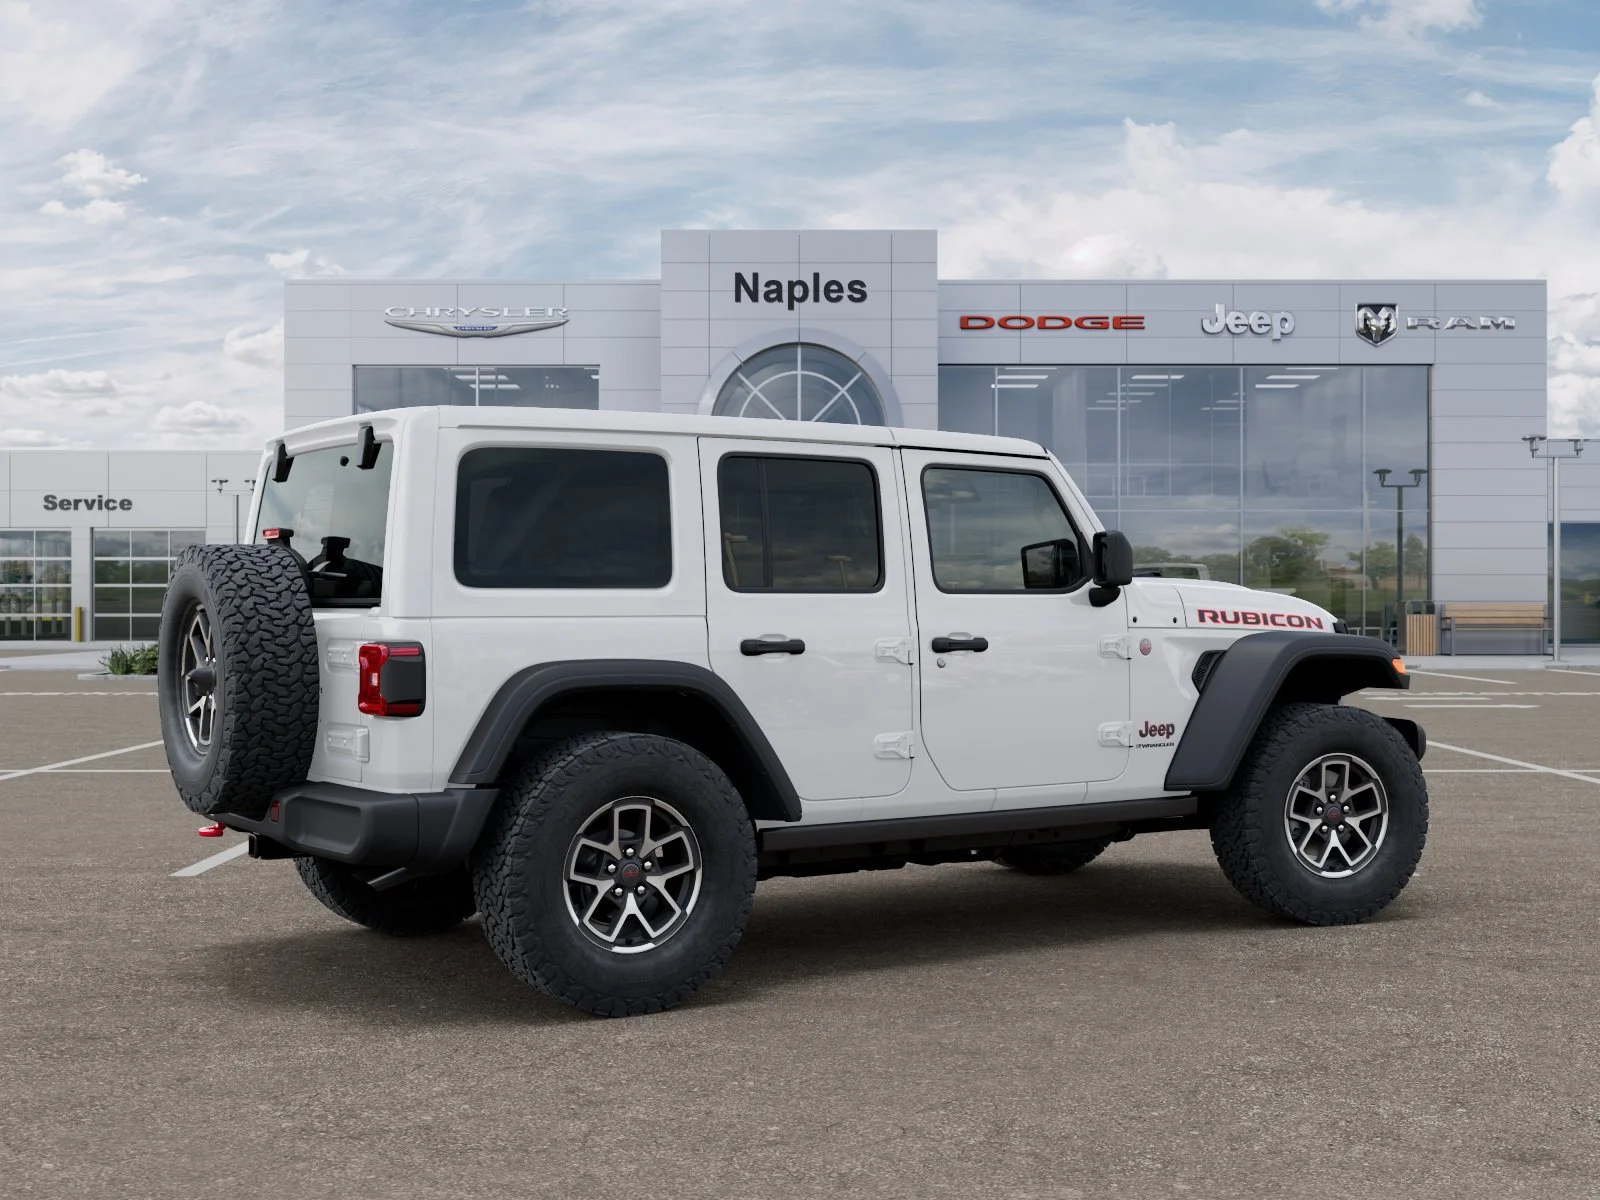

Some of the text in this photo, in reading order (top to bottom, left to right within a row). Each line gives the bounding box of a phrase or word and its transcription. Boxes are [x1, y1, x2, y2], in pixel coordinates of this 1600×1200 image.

[734, 271, 868, 311] Naples
[384, 305, 569, 318] CHRYSLER
[959, 315, 1146, 330] DODGE
[1201, 303, 1295, 342] Jeep
[1406, 316, 1516, 330] RAM
[43, 494, 133, 511] Service
[1197, 609, 1324, 630] RUBICON
[1138, 720, 1175, 740] Jeep
